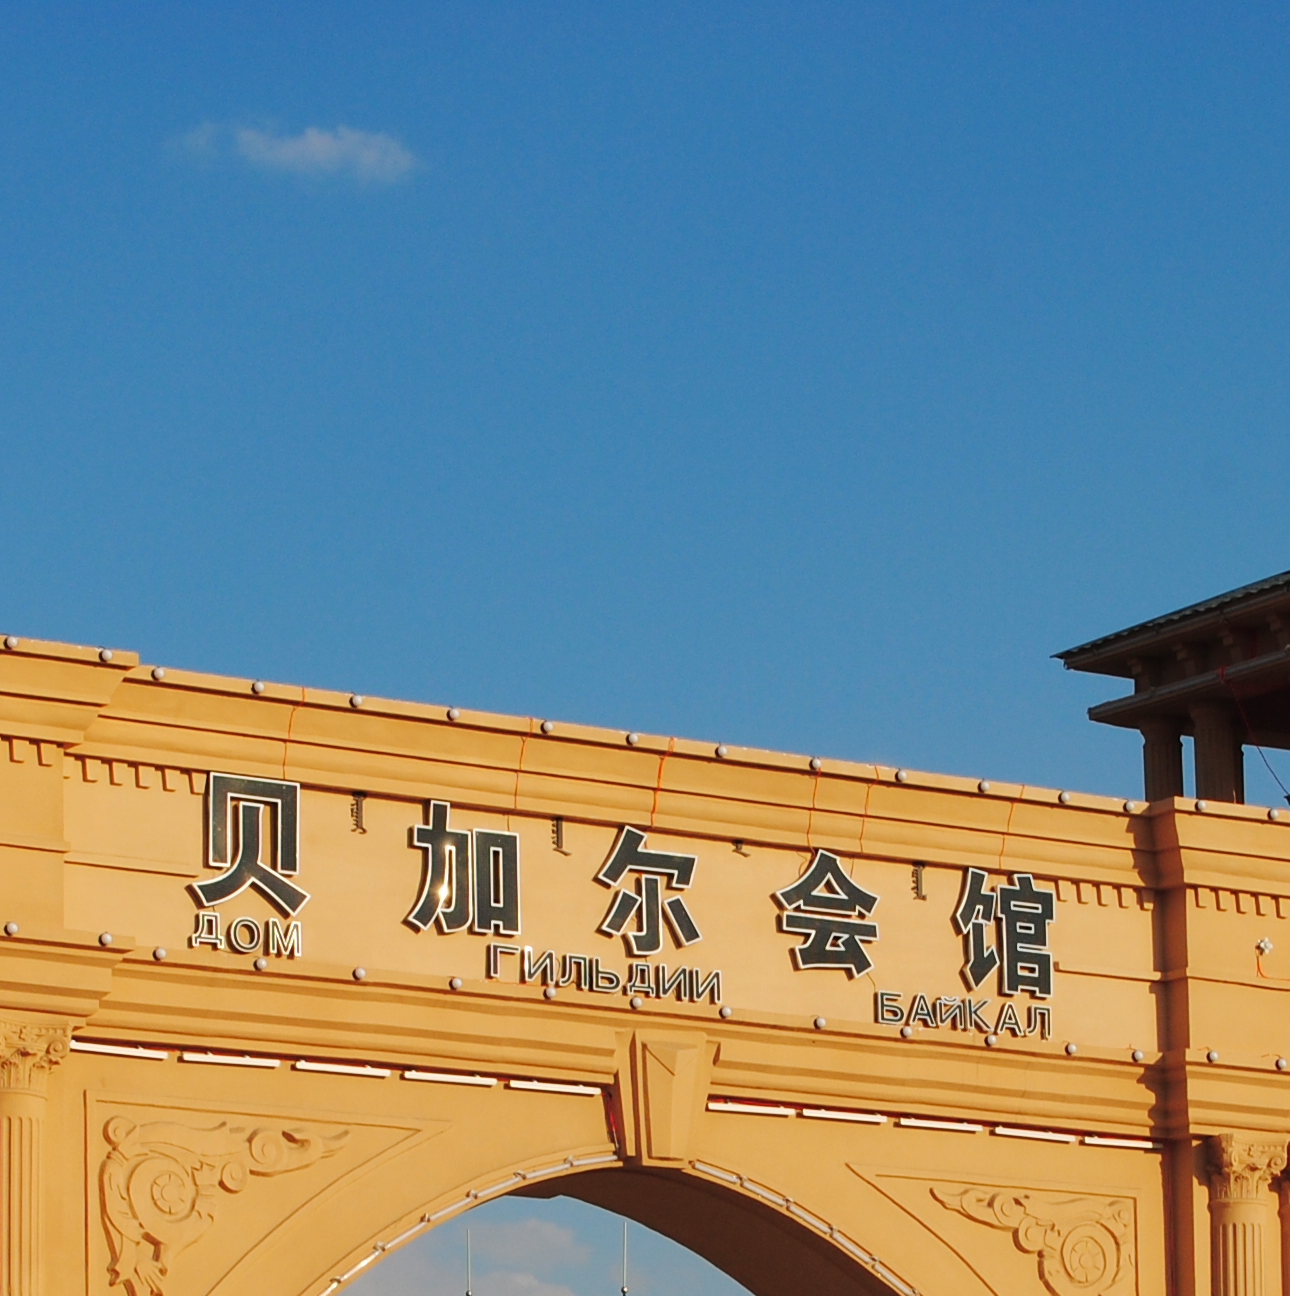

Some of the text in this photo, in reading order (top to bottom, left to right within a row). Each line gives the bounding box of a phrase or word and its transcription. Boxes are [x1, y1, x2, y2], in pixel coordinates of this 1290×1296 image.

[190, 771, 1058, 998] 贝加尔会馆
[192, 911, 1053, 1039] ДОМ ГИЛЬДИИ БАЙКАЛ
